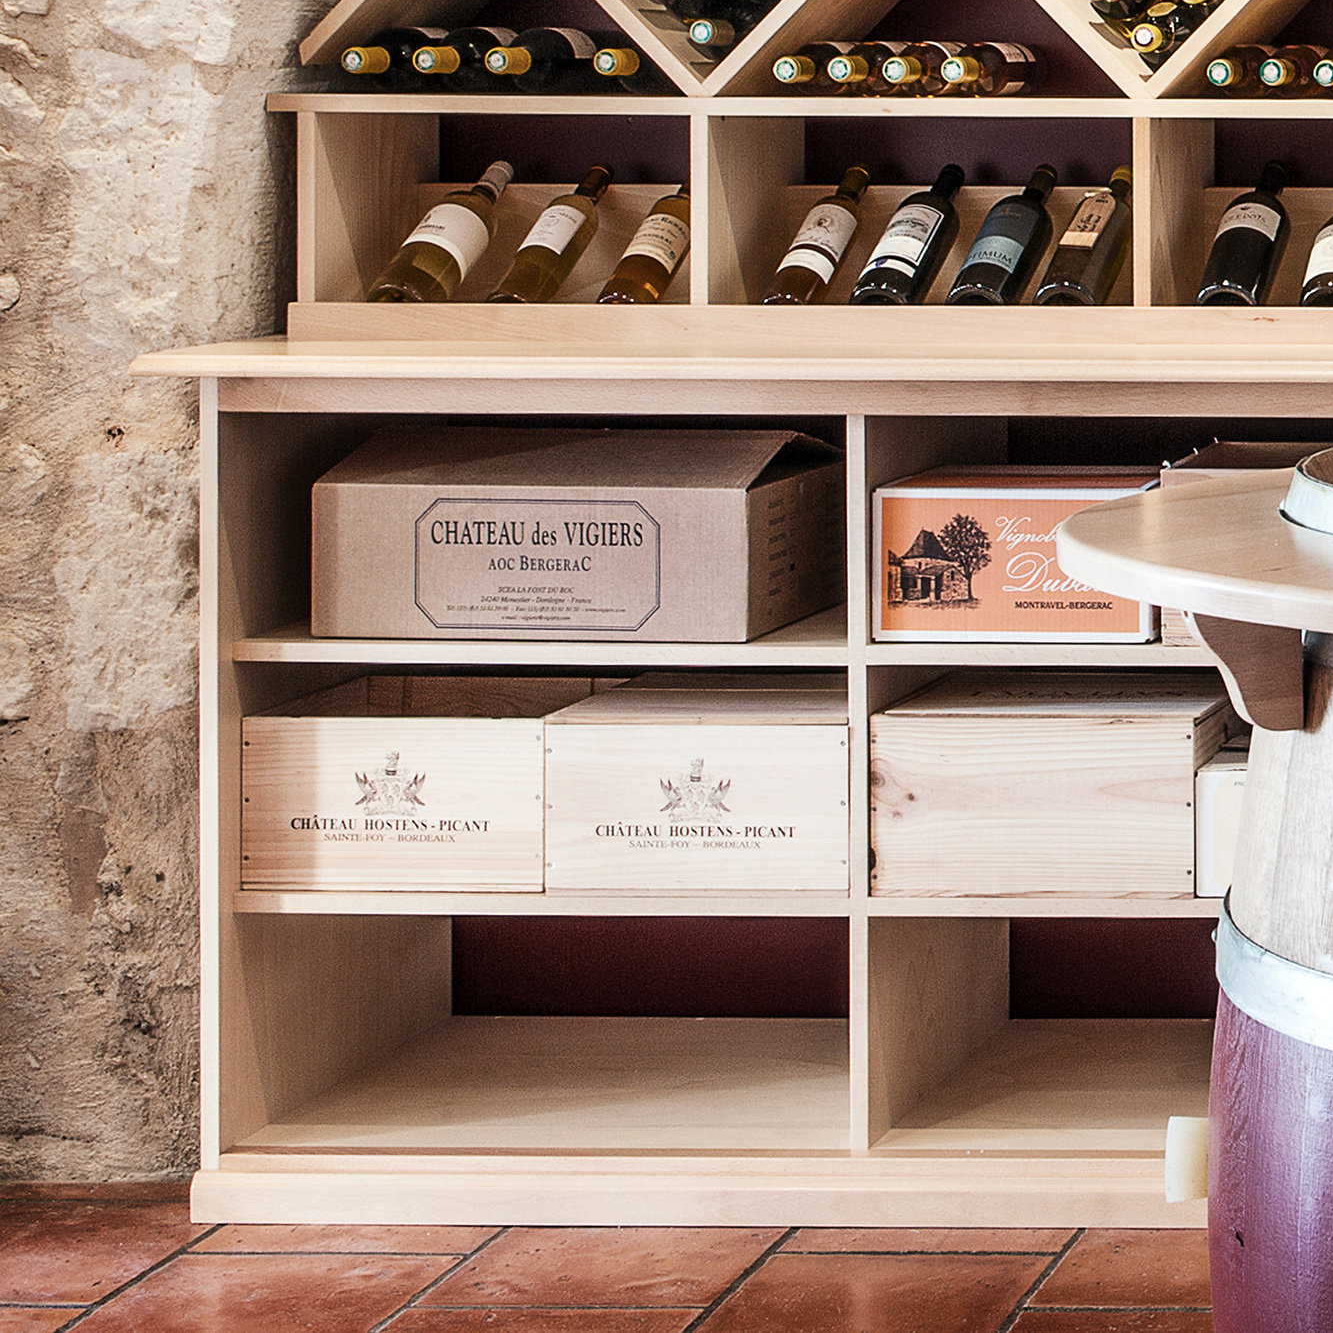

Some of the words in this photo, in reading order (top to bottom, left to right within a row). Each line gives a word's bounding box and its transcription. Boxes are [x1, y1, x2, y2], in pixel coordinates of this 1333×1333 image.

[431, 520, 525, 546] CHATEAU
[531, 521, 557, 546] des
[563, 522, 643, 547] VIGIERS
[488, 557, 515, 571] AOC
[519, 555, 591, 572] BERGERAC
[1015, 601, 1113, 610] MONTRAVEL-BERGERAC
[290, 814, 357, 830] CHÂTEAU
[364, 818, 428, 831] HOSTENS
[439, 819, 490, 832] PICANT
[595, 822, 662, 837] CHÂTEAU
[669, 825, 733, 837] HOSTENS
[744, 826, 796, 838] PICANT
[323, 833, 386, 842] SAINTE-FOY
[397, 834, 456, 843] BORDEAUX
[628, 840, 691, 849] SAINTE-FOY
[702, 841, 761, 849] BORDEAUX
